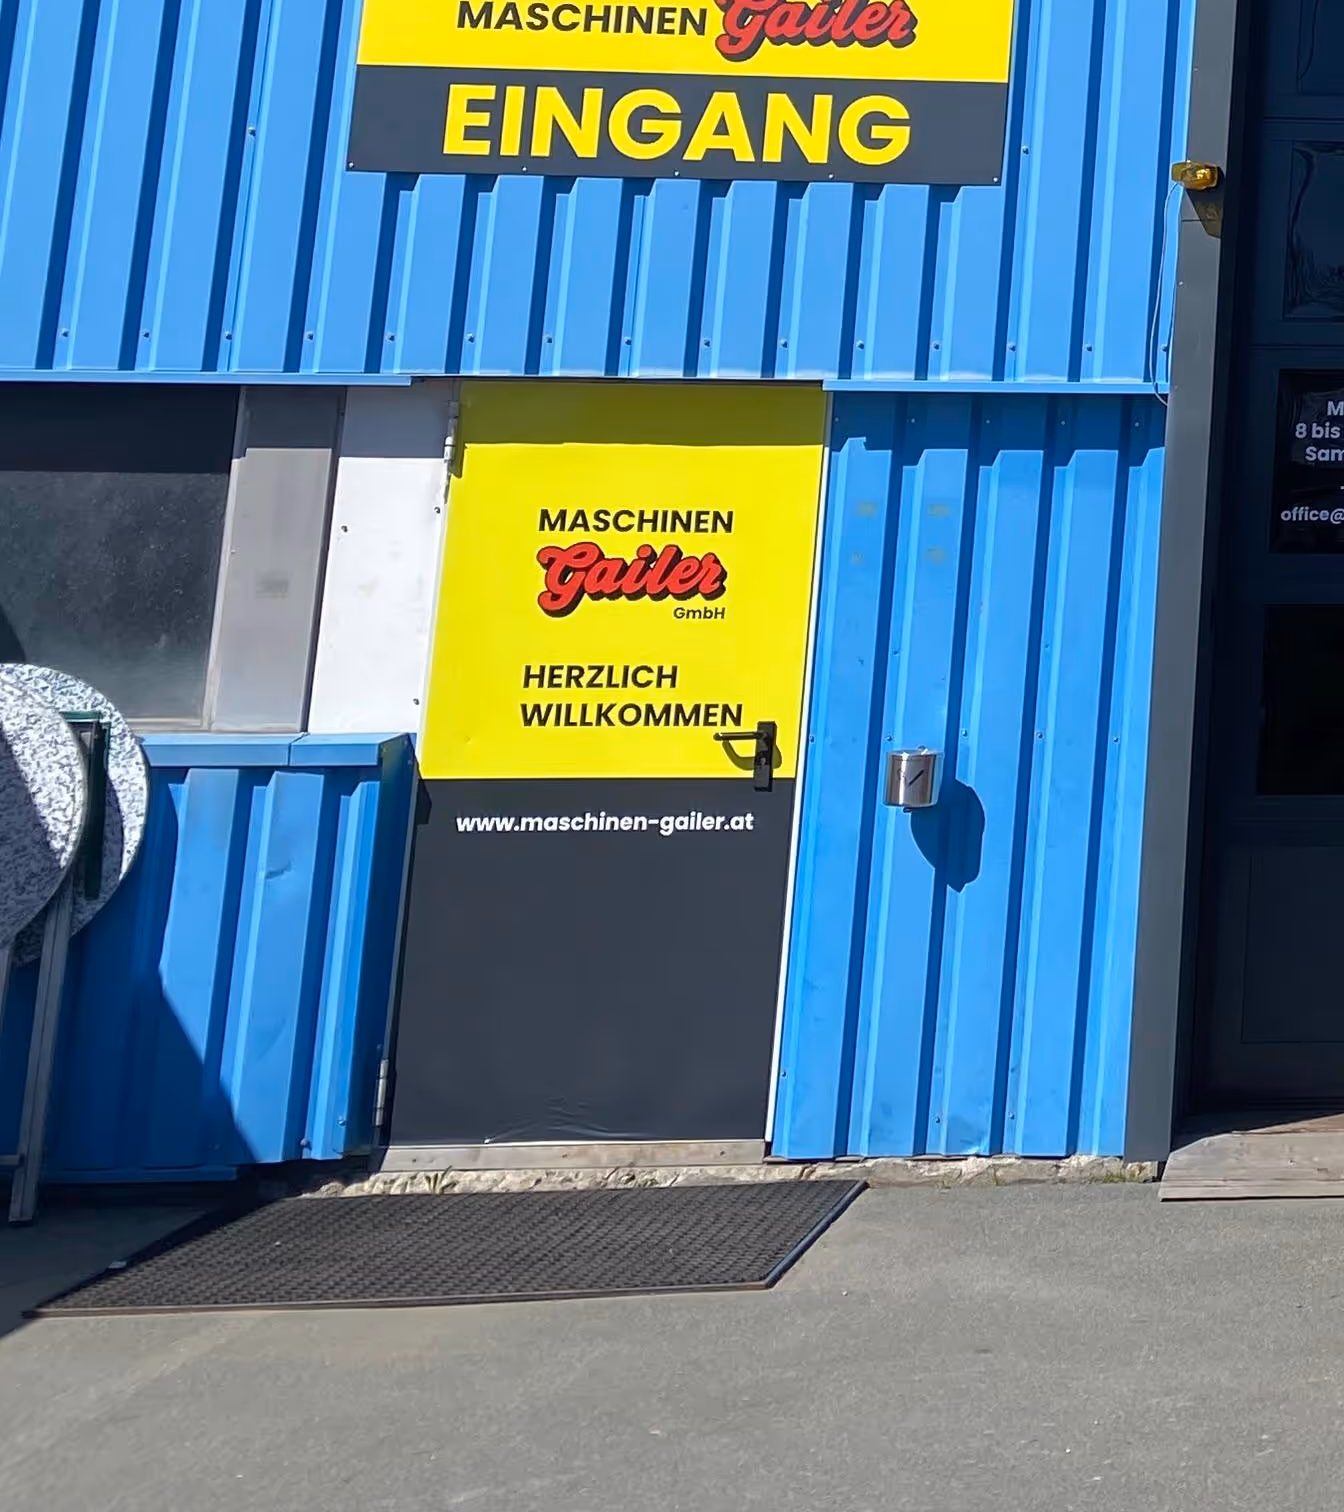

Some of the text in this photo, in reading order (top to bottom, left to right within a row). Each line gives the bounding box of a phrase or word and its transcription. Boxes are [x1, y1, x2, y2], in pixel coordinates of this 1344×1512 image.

[457, 0, 707, 36] MASCHINEN
[443, 83, 911, 166] EINGANG
[1295, 422, 1307, 440] 8
[1312, 422, 1341, 440] bis
[538, 508, 734, 534] MASCHINEN
[536, 541, 728, 618] Gailer
[673, 606, 726, 620] GmbH
[523, 664, 678, 689] HERZLICH
[520, 703, 743, 727] WILLKOMMEN
[456, 810, 755, 836] www.maschinen-gailer.at
